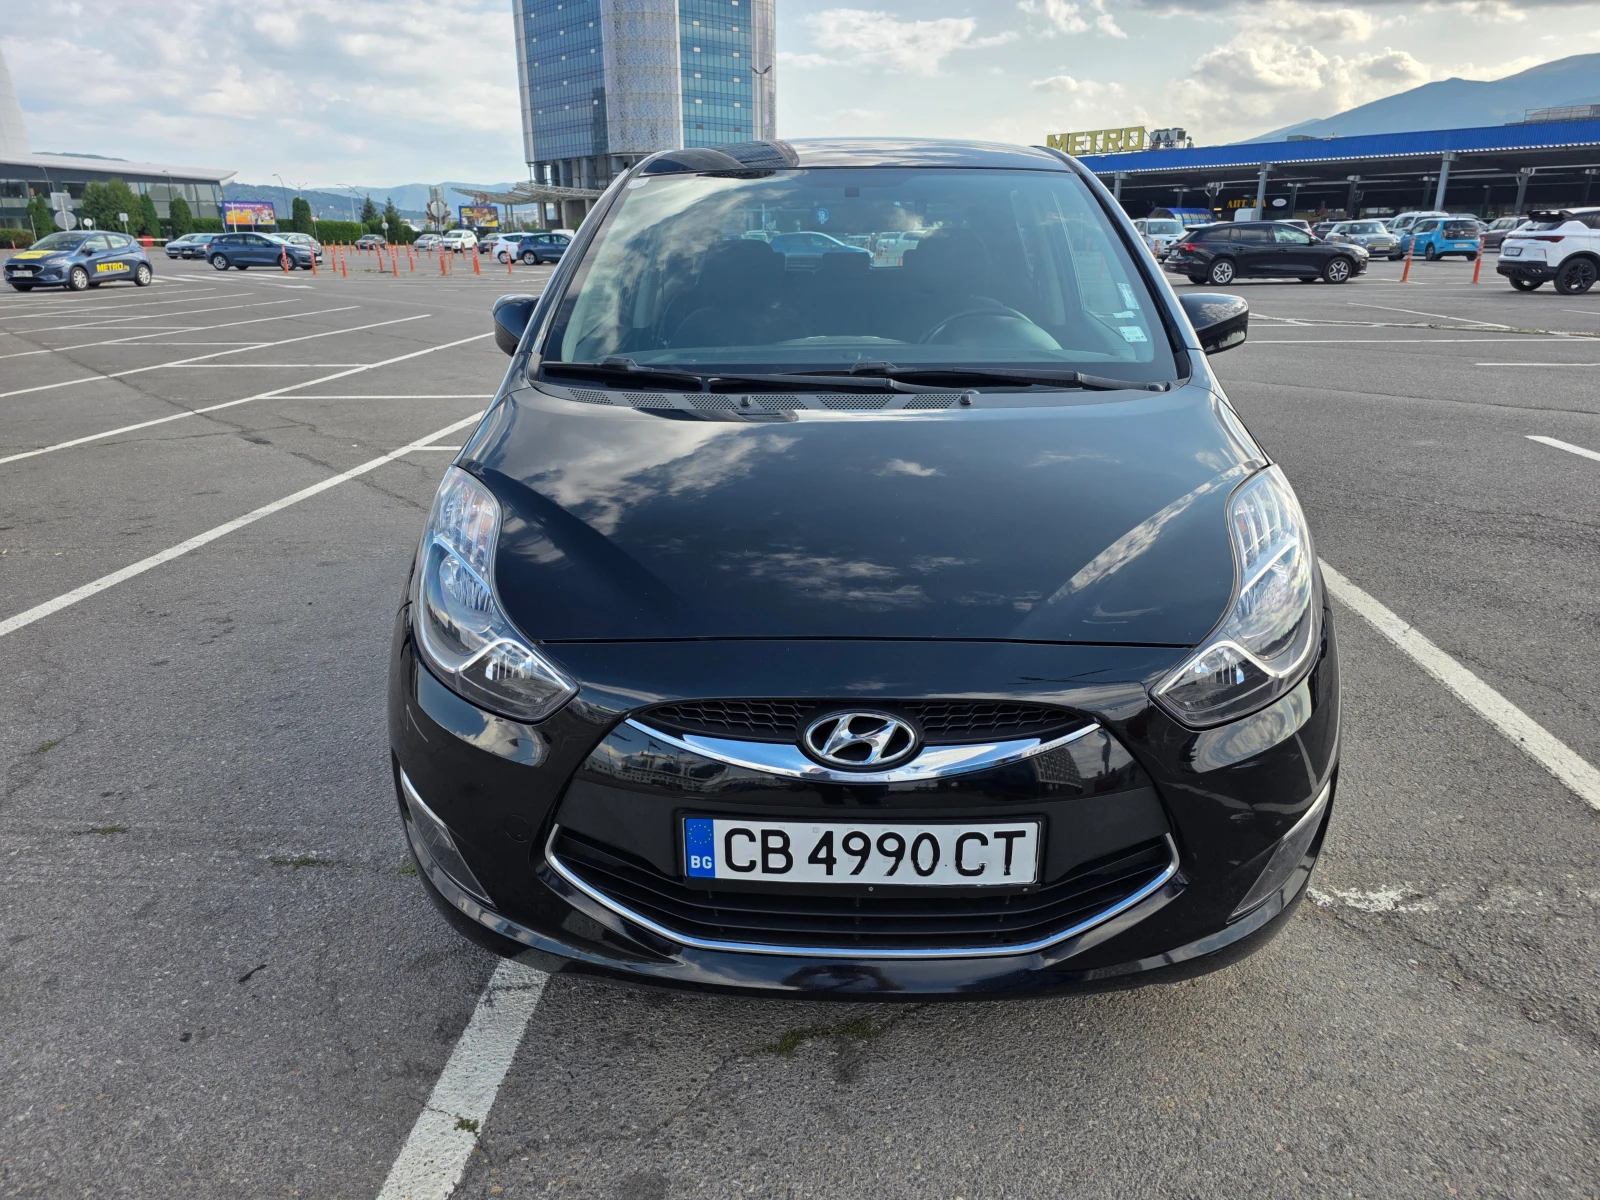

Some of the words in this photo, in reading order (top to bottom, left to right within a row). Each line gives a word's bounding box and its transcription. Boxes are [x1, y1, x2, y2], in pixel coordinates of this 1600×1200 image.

[1047, 126, 1144, 156] METRO
[690, 855, 713, 869] BG
[724, 827, 794, 874] CB
[807, 830, 941, 877] 4990
[955, 830, 1026, 877] CT
